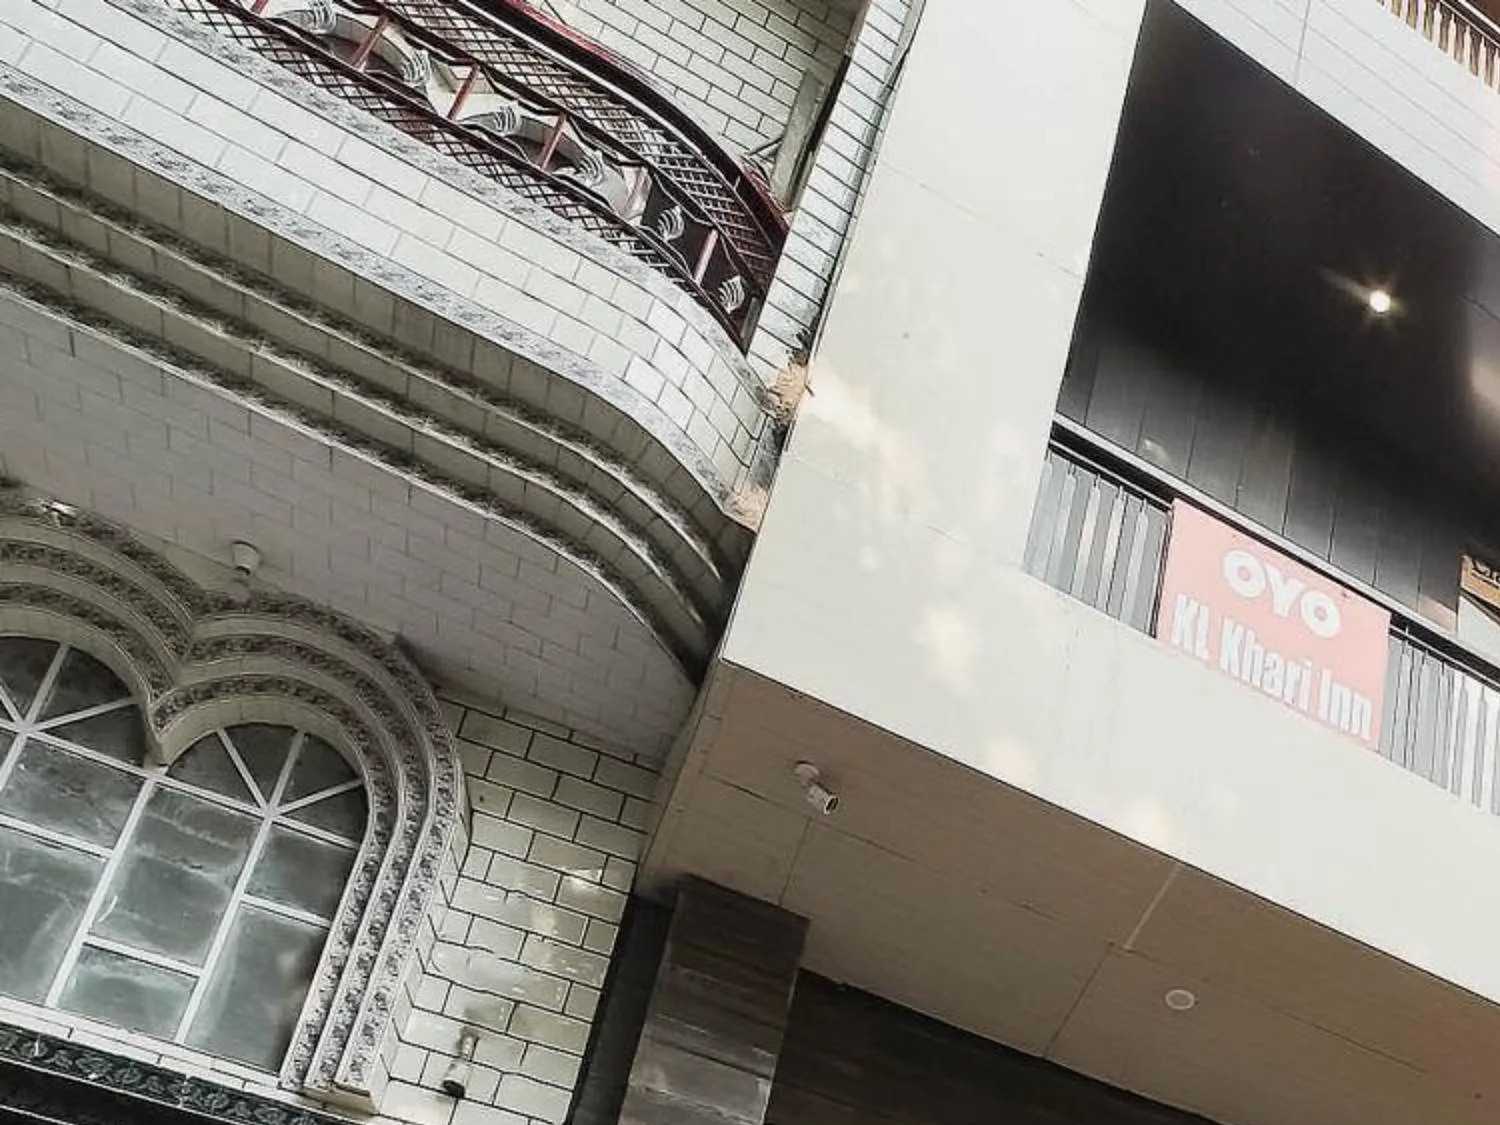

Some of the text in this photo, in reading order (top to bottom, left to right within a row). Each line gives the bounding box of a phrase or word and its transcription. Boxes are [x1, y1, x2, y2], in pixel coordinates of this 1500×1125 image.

[1222, 549, 1342, 639] OYO
[1171, 594, 1373, 741] KL Khari Inn
